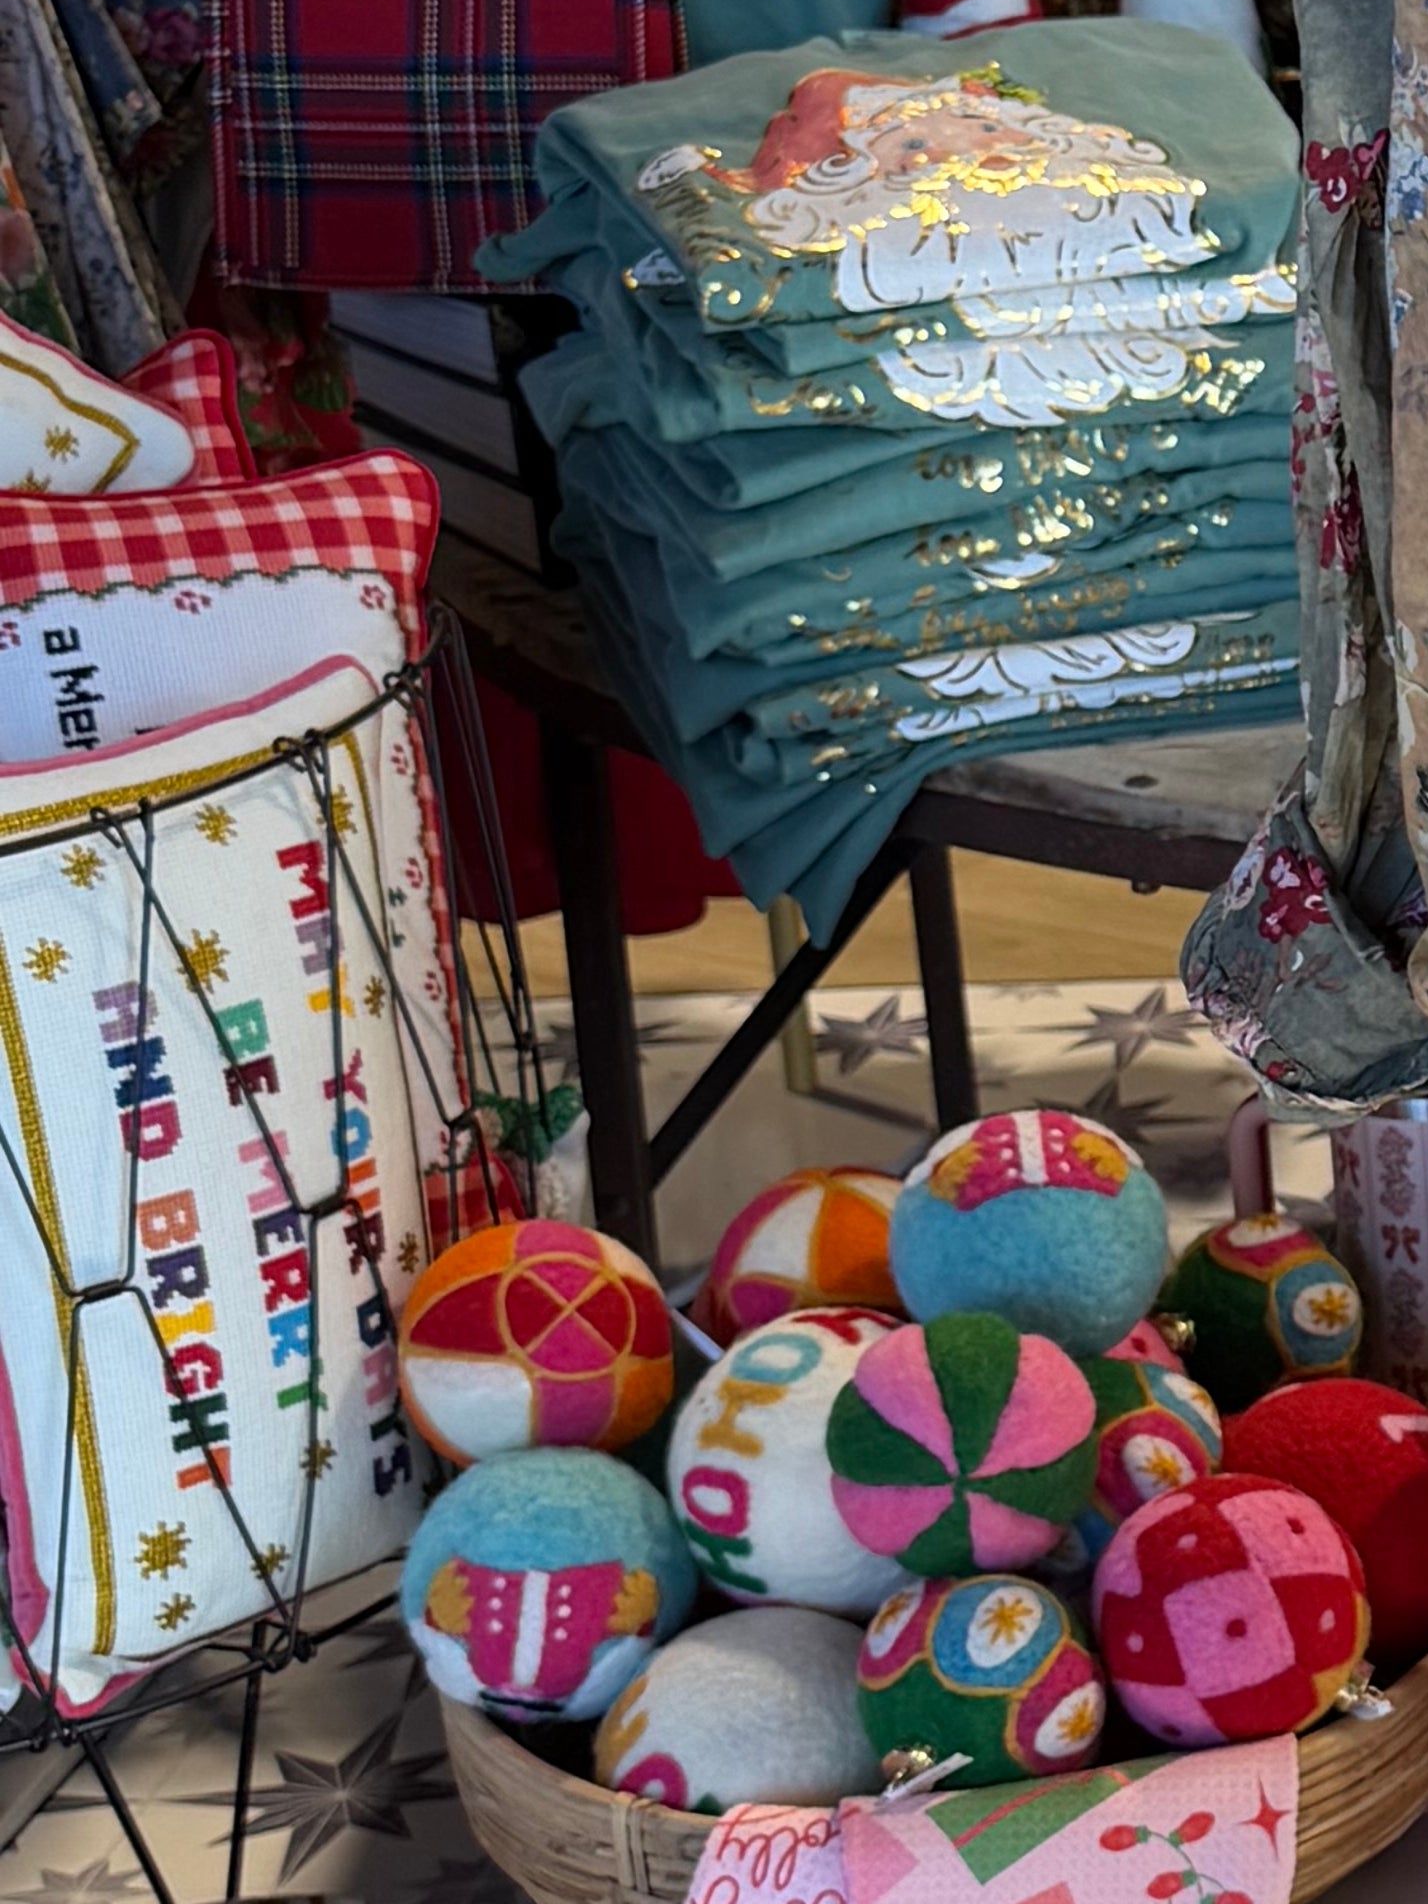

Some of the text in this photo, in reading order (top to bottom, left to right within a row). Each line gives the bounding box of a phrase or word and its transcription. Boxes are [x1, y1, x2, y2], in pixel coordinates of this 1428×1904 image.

[43, 625, 105, 752] a Mer
[93, 980, 233, 1491] AND BRIGHT
[215, 998, 328, 1412] BE MERRY
[276, 840, 413, 1498] MAY YOUR DAYS
